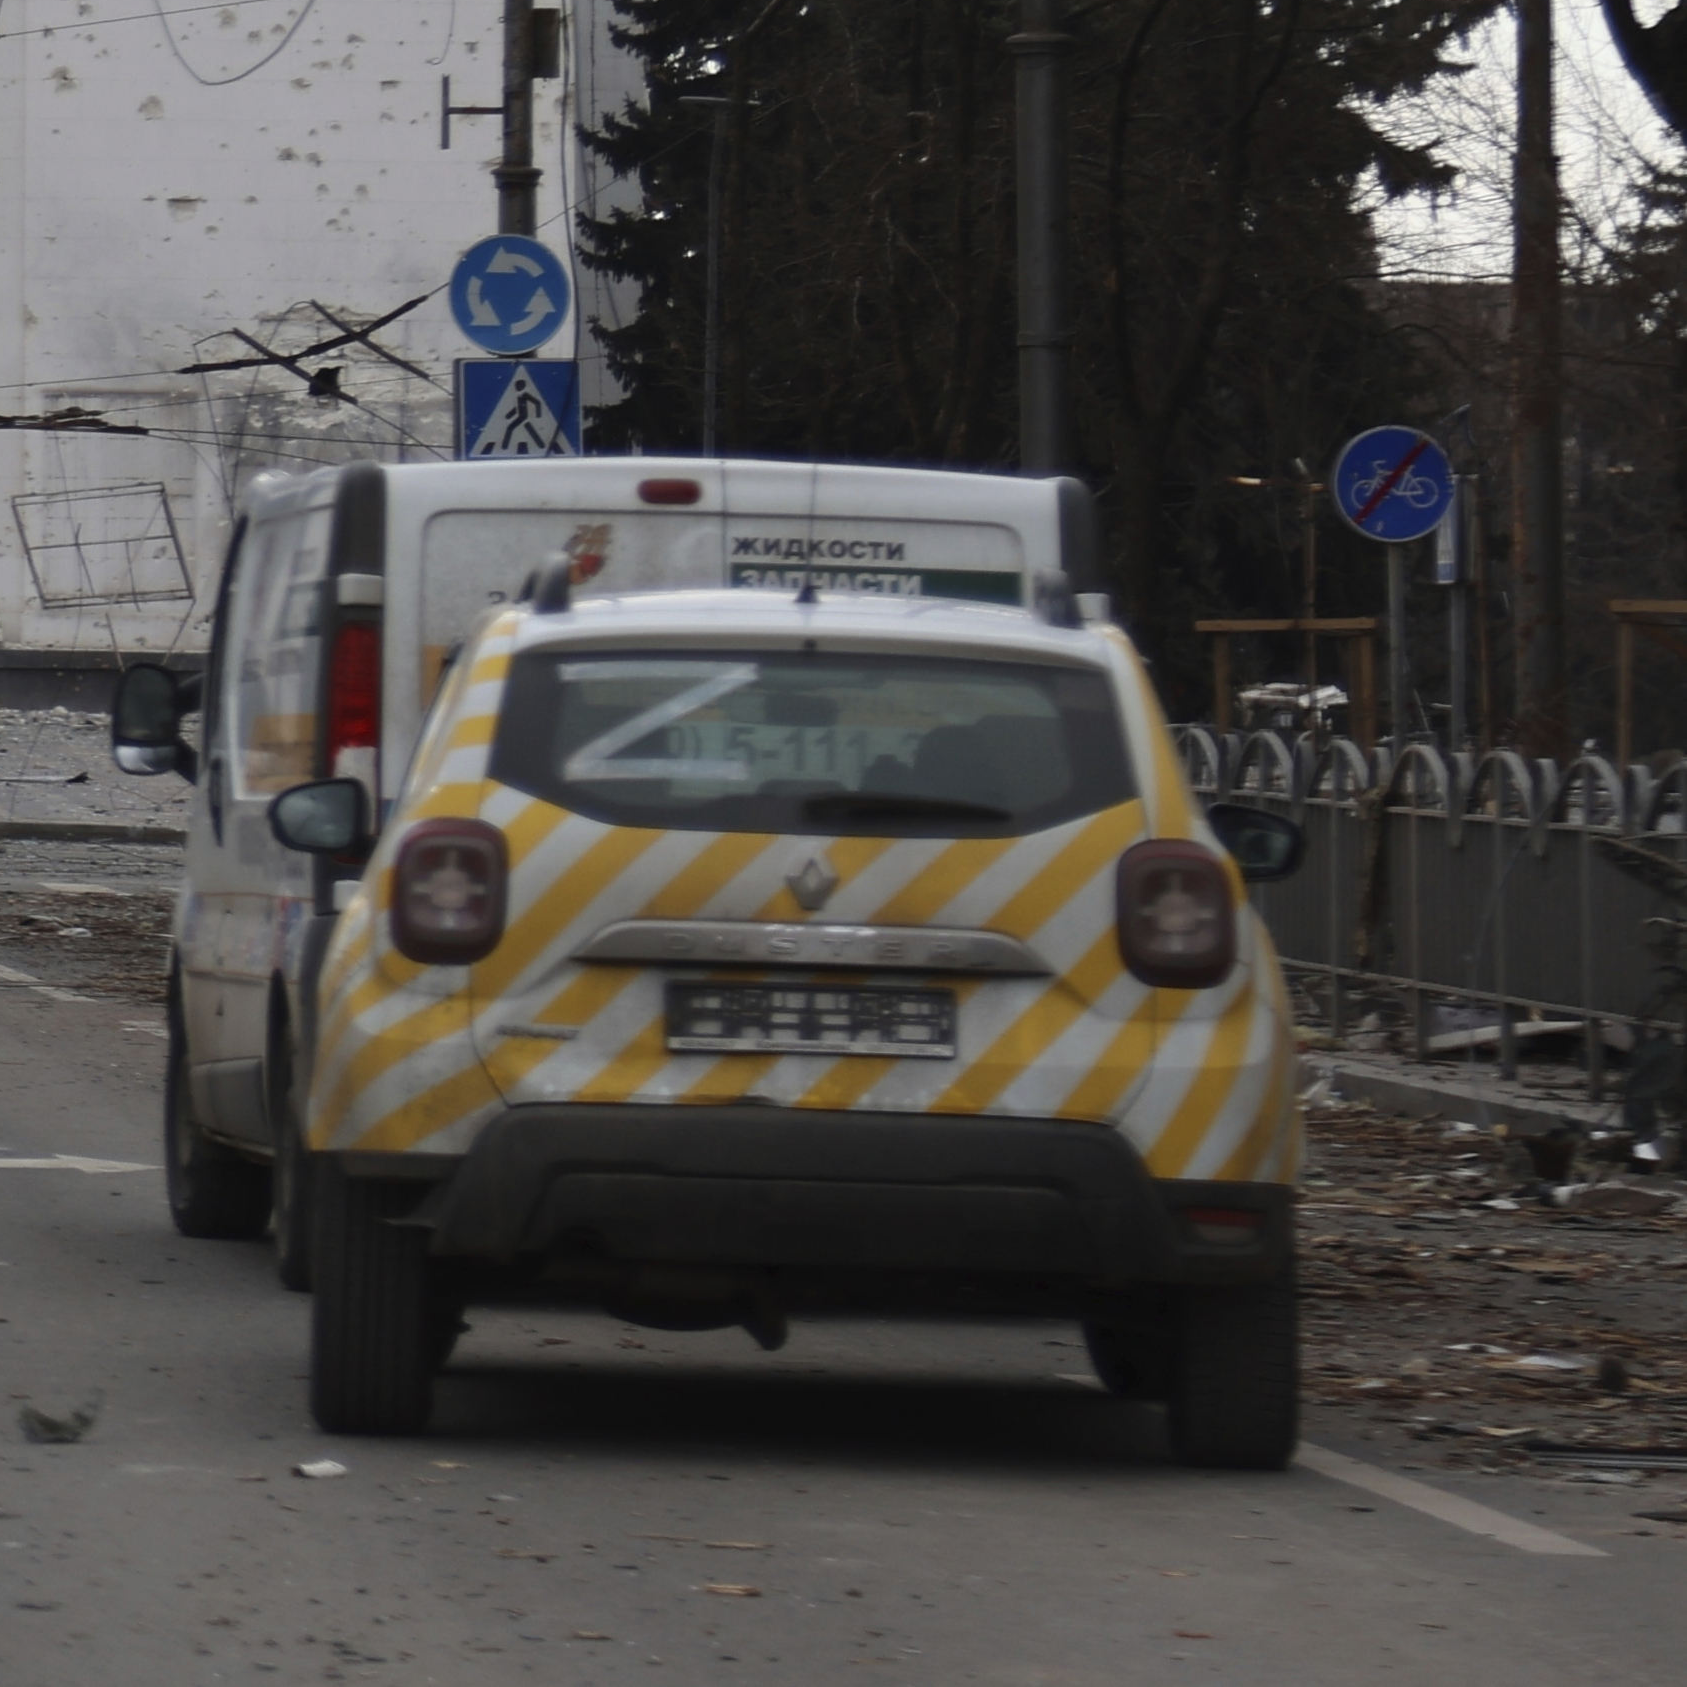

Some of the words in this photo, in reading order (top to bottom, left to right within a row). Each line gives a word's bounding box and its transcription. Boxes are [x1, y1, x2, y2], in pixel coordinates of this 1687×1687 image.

[731, 537, 906, 561] ЖИДКОСТИ
[740, 569, 923, 596] ЗАПЧАСТИ
[664, 932, 959, 963] DUSTER
